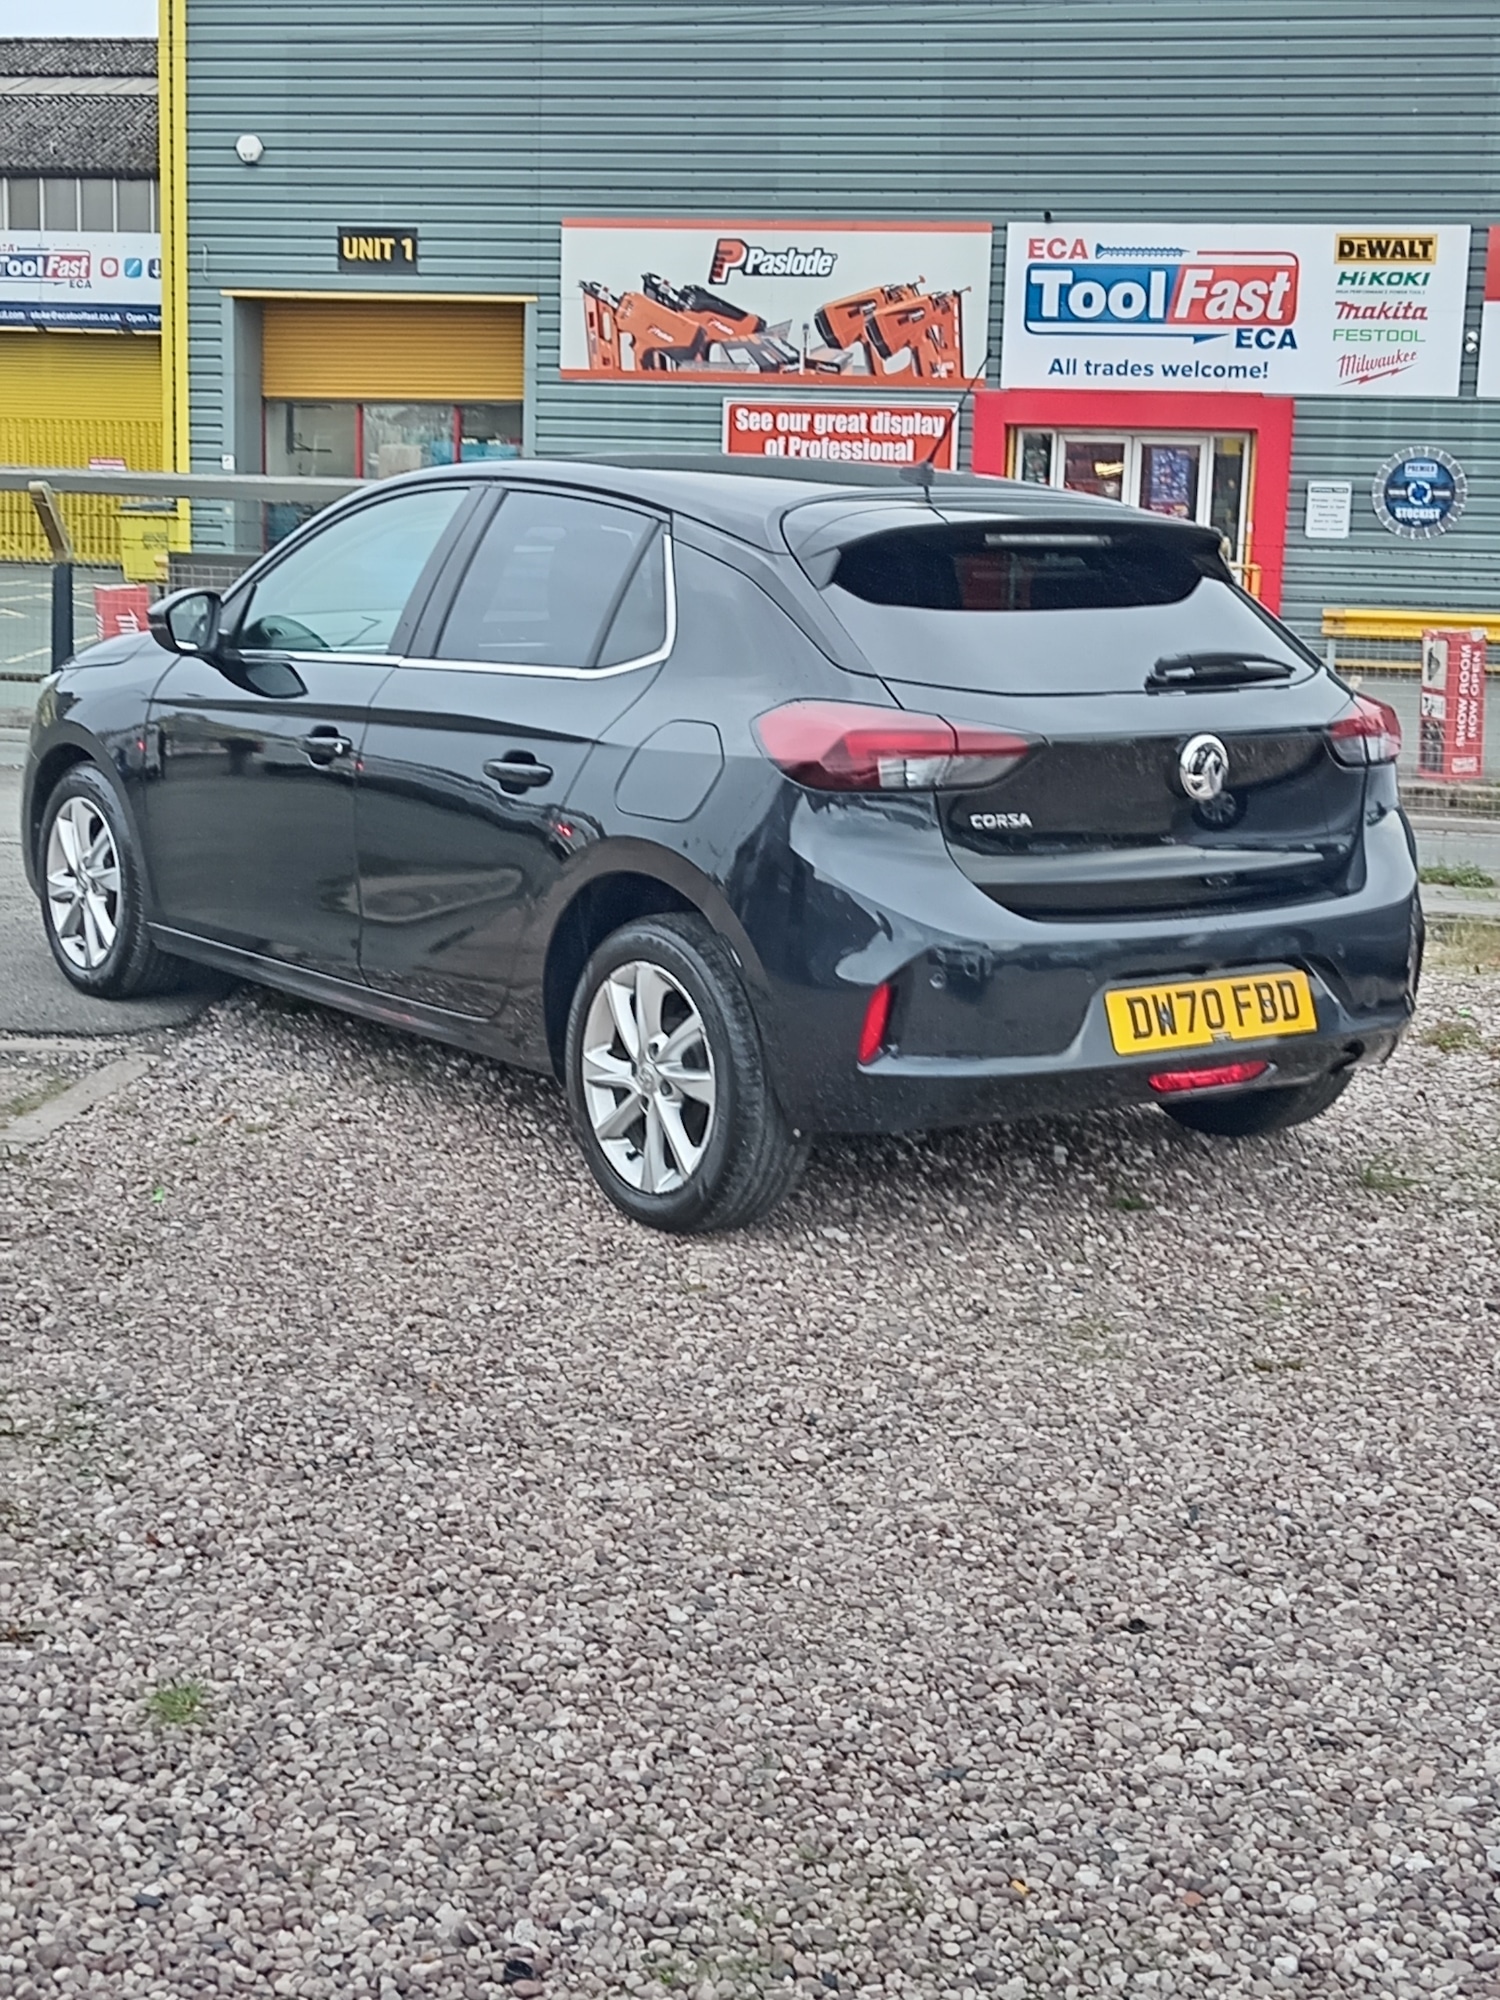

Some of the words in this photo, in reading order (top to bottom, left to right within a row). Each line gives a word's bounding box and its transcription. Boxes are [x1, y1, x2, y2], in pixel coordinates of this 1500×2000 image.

[343, 236, 396, 261] UNIT
[401, 237, 413, 261] 1
[1027, 238, 1089, 260] ECA
[744, 247, 835, 276] Paslode
[69, 279, 92, 289] ECA
[126, 312, 147, 323] Open
[1235, 327, 1298, 350] ECA
[1333, 328, 1426, 342] FESTOOL
[1048, 358, 1077, 377] All
[1084, 359, 1154, 377] trades
[1161, 360, 1270, 379] welcome!
[1336, 349, 1418, 378] Milwaukee
[735, 407, 774, 431] See
[776, 411, 812, 432] our
[813, 412, 869, 435] great
[870, 411, 946, 438] display
[764, 436, 786, 459] of
[789, 437, 915, 462] Professional
[1394, 507, 1441, 520] STOCKIST
[1458, 643, 1472, 696] ROOM
[1469, 650, 1481, 697] OPEN
[1455, 698, 1468, 748] SHOW
[1467, 699, 1478, 739] NOW
[969, 813, 1033, 830] CORSA
[1126, 988, 1226, 1040] DW70
[1231, 979, 1301, 1028] FBD
